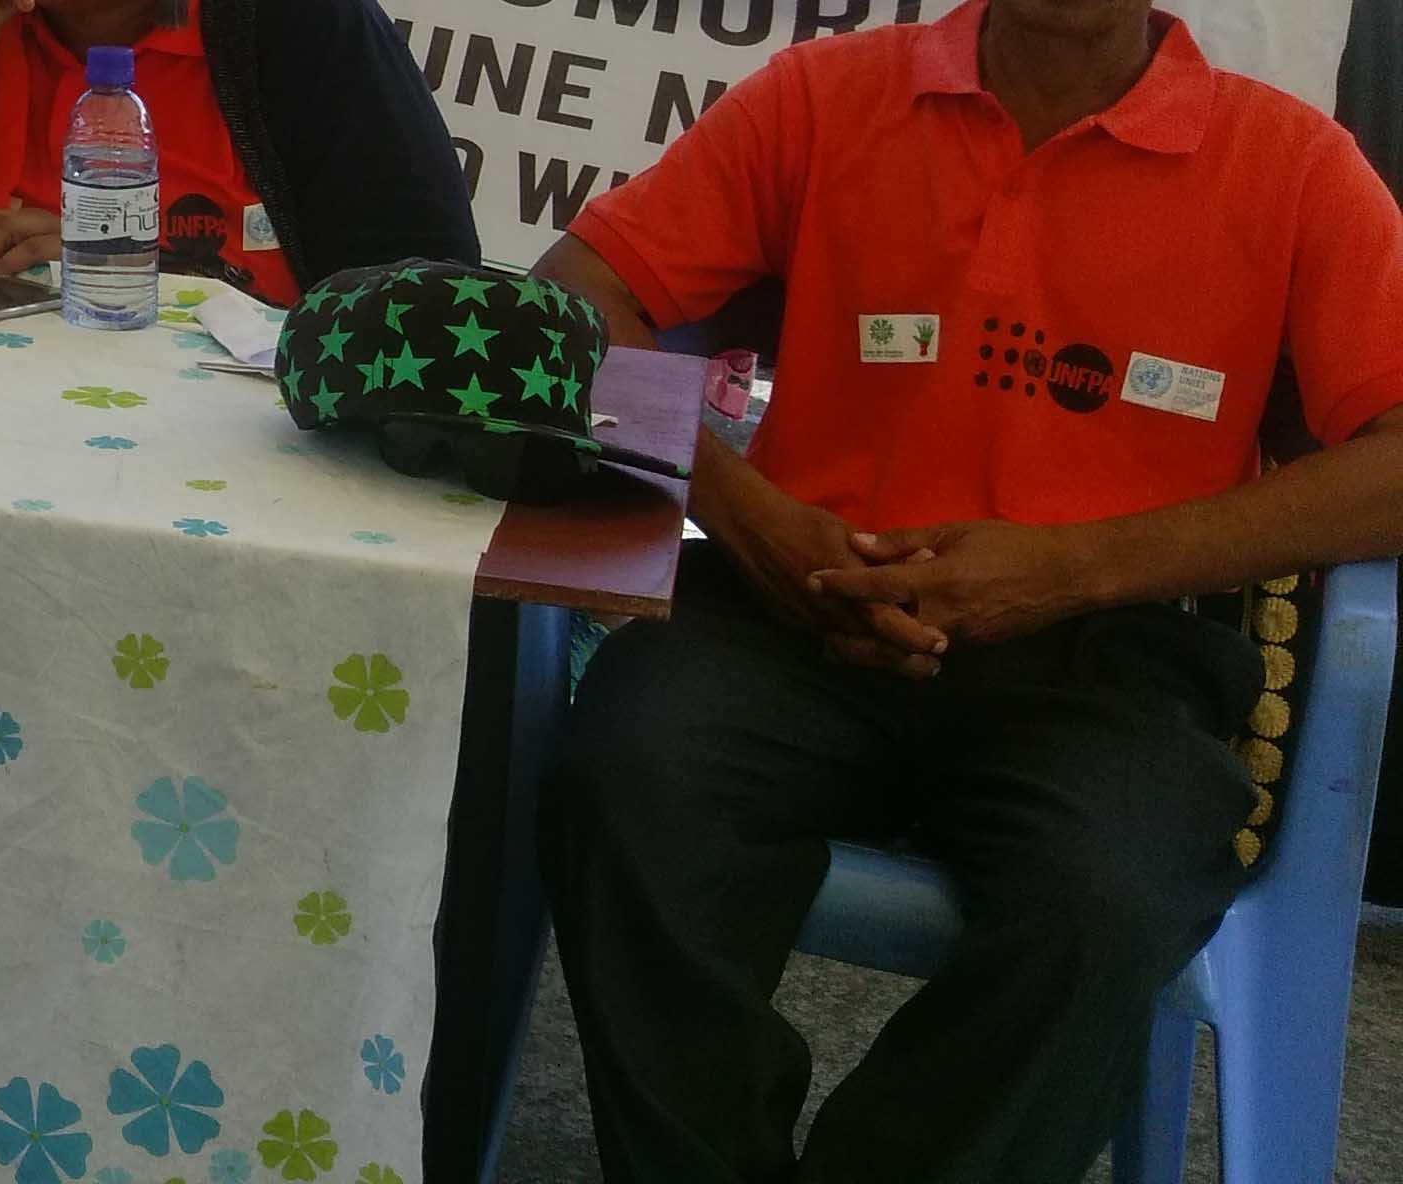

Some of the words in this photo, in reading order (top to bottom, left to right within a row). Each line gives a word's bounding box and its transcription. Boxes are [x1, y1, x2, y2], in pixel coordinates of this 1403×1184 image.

[518, 150, 630, 232] W
[167, 214, 227, 239] UNFPA
[1049, 359, 1114, 397] UNFPA
